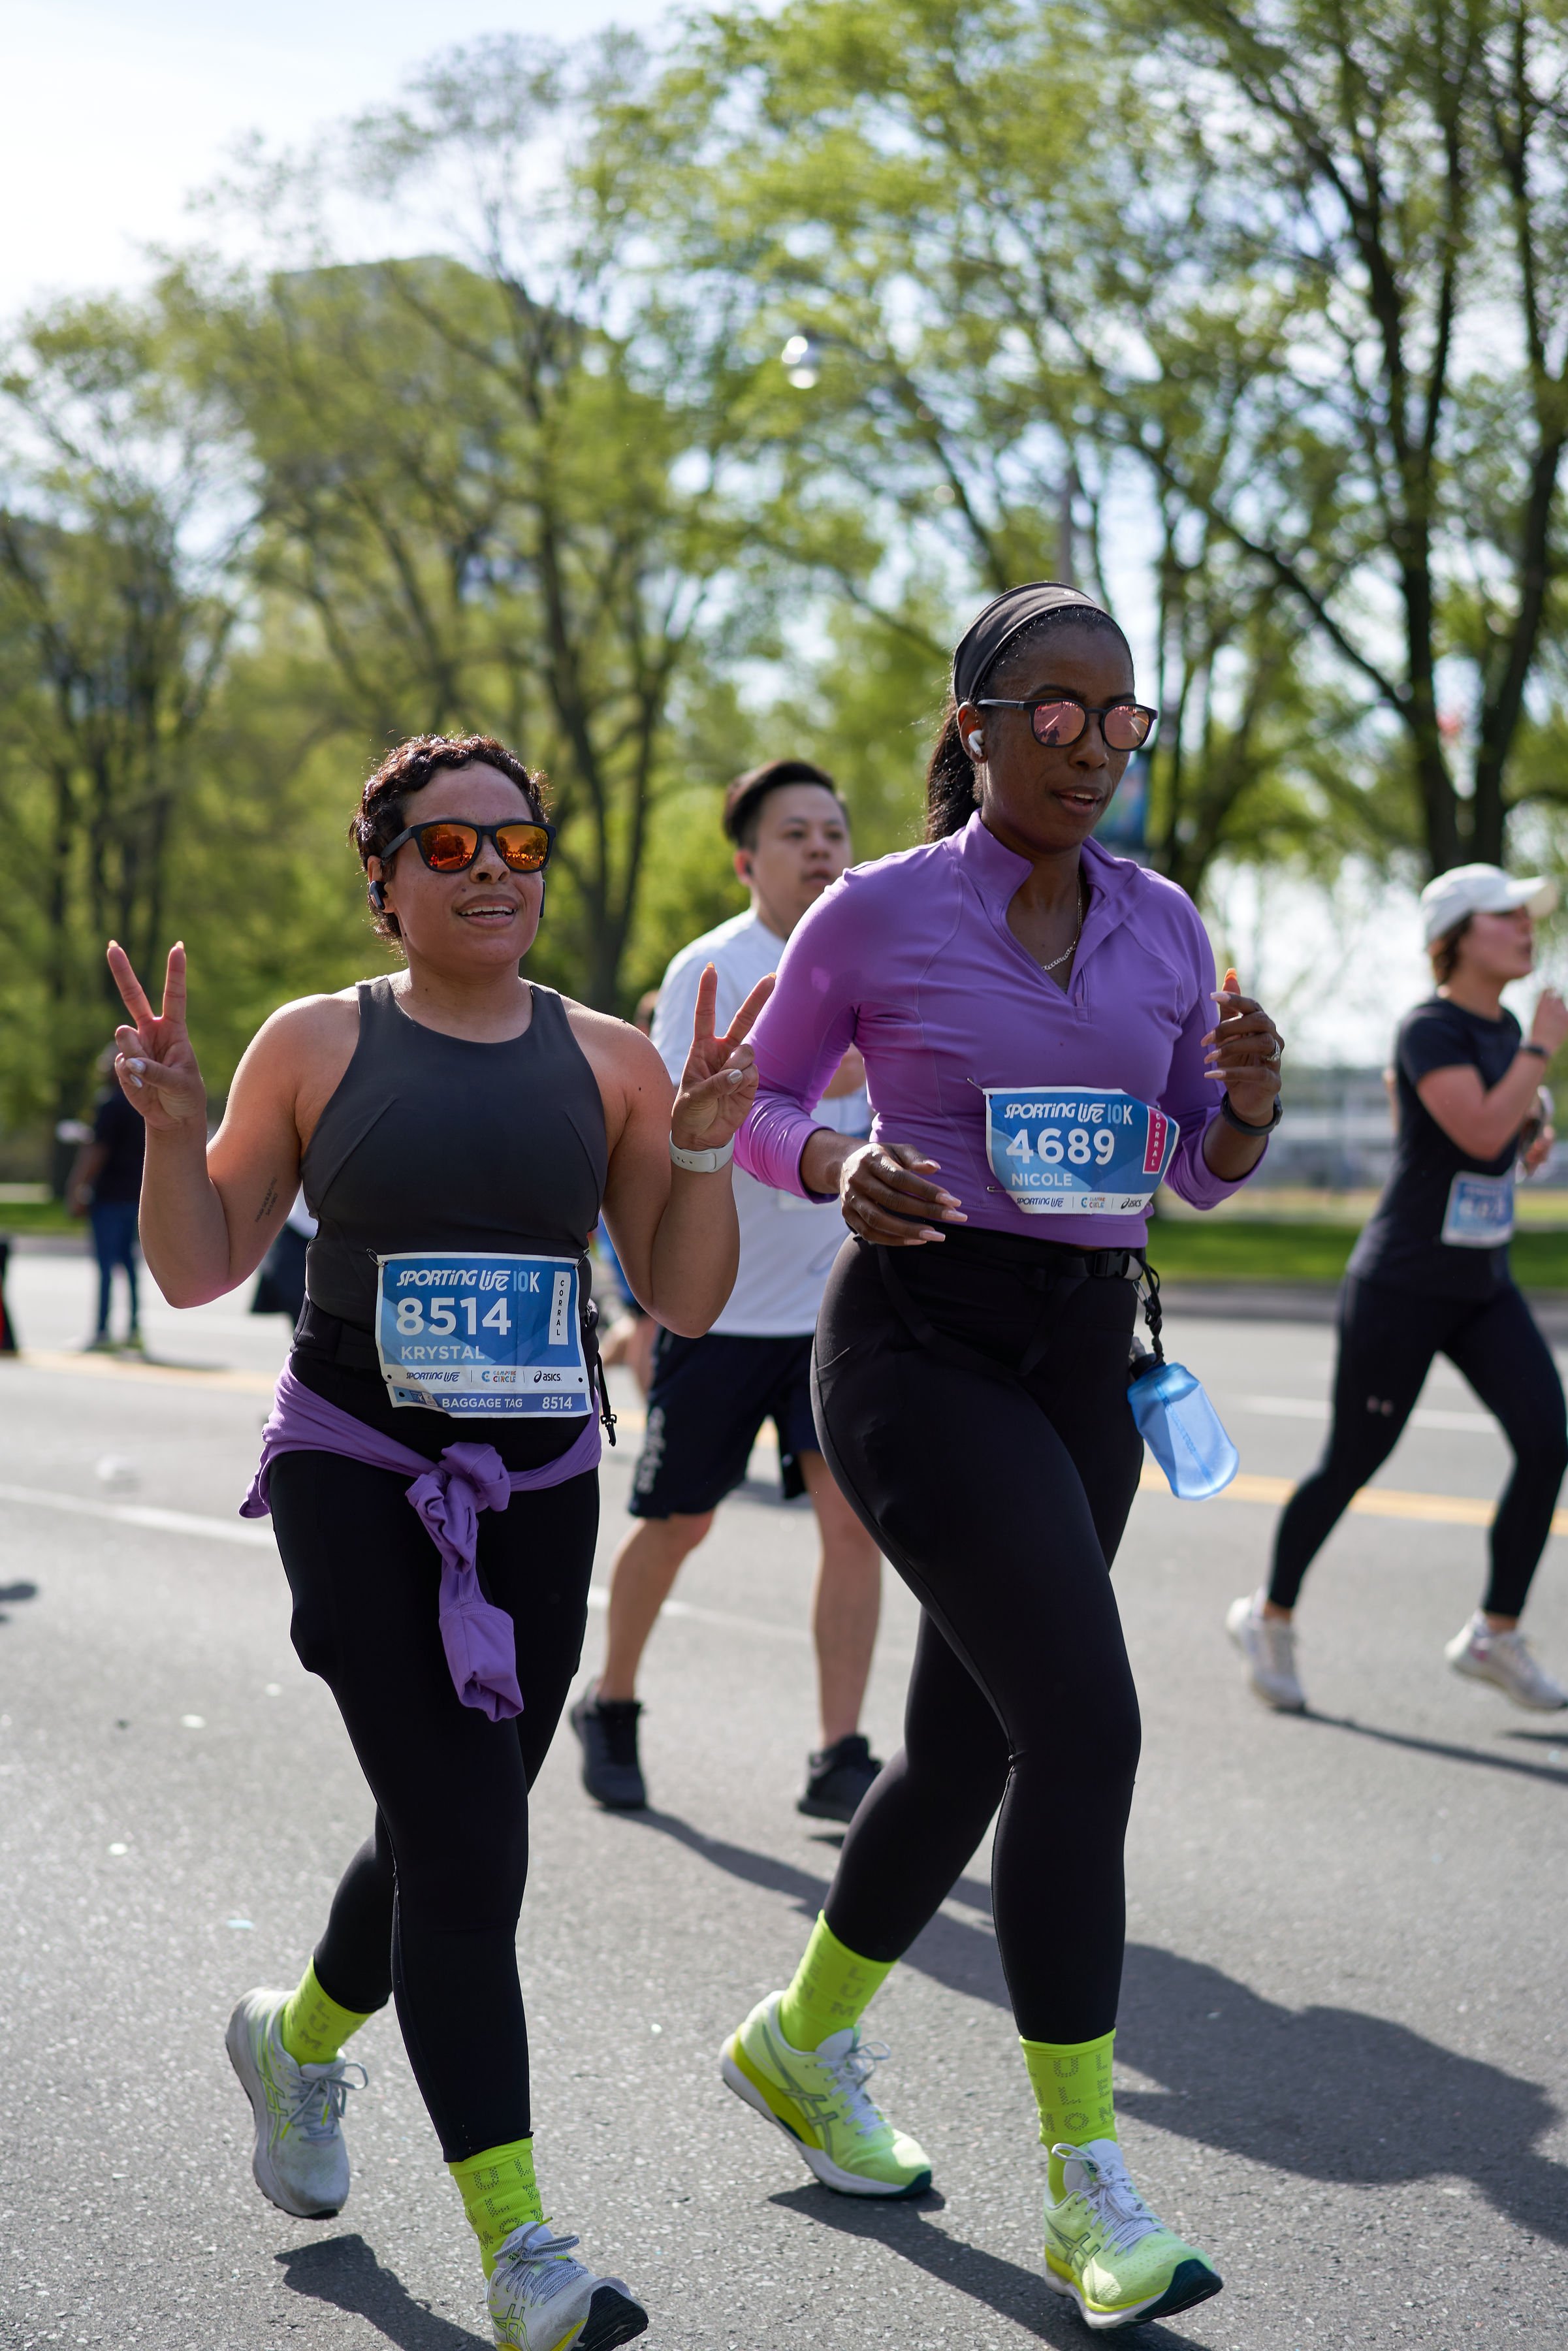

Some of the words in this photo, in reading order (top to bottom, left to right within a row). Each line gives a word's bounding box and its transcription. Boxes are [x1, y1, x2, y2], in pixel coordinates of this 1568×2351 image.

[1108, 1104, 1132, 1125] 10K
[1006, 1128, 1115, 1165] 4689
[1151, 1113, 1160, 1166] CORRAL
[1012, 1173, 1072, 1186] NICOLE
[513, 1271, 540, 1293] 10K
[396, 1297, 511, 1335] 8514
[401, 1345, 485, 1360] KRYSTAL
[442, 1398, 501, 1409] BAGGAGE
[504, 1398, 522, 1409] TAG
[542, 1396, 573, 1409] 8514
